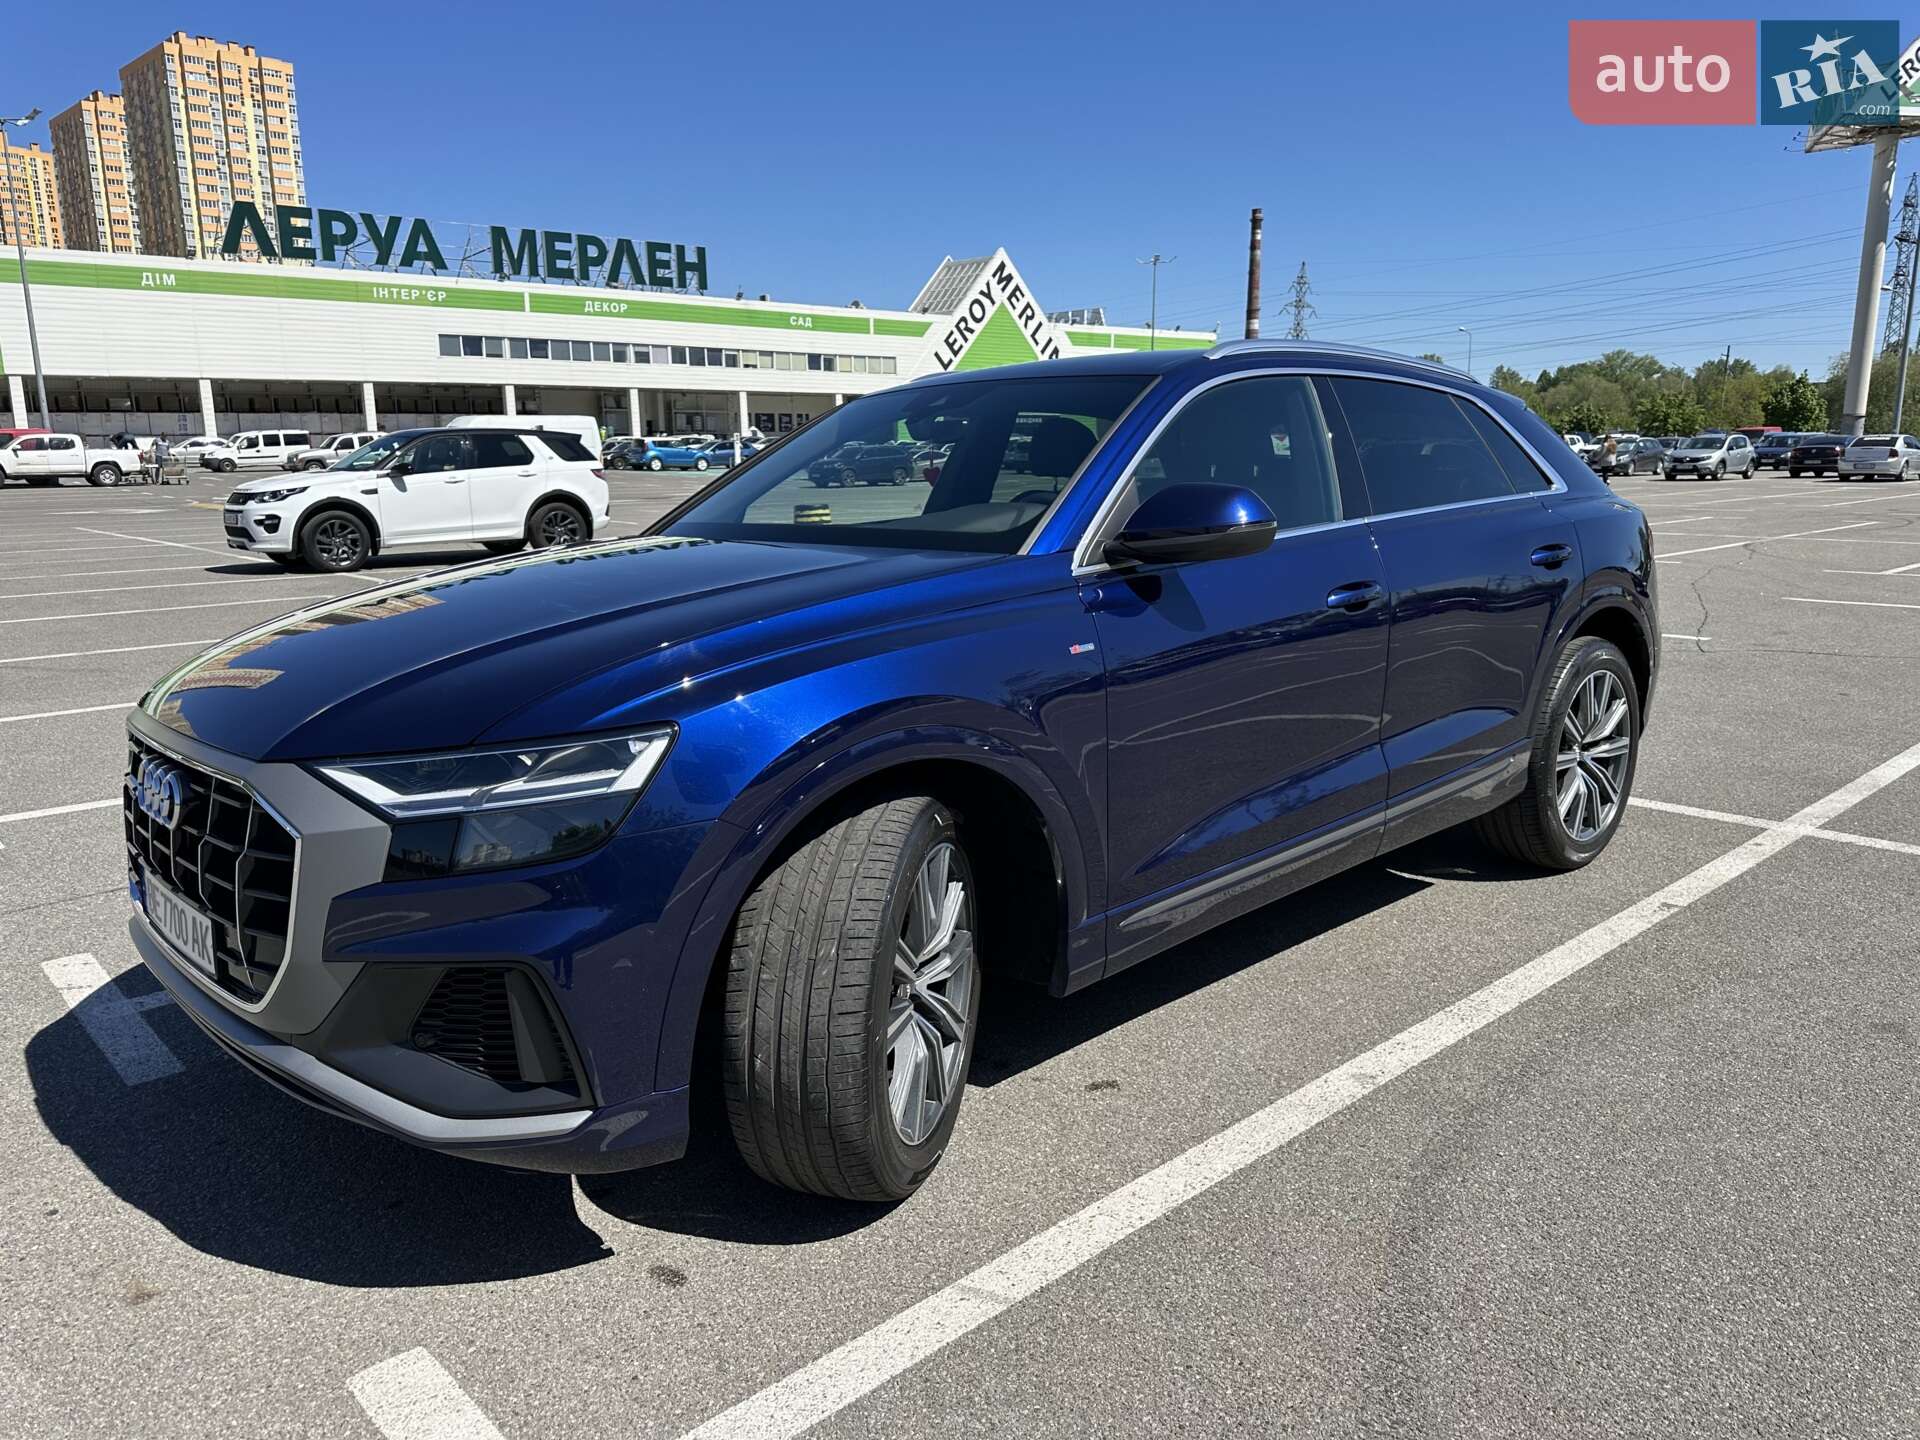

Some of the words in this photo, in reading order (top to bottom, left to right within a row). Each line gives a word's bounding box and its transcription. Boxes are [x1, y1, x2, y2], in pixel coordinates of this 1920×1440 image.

[221, 200, 448, 270] ЛЕРУА
[490, 226, 708, 290] МЕРЛЕН
[141, 271, 176, 287] ДІМ
[584, 300, 628, 313] ДЕКОР
[789, 316, 813, 328] САД
[934, 280, 995, 371] LEROY
